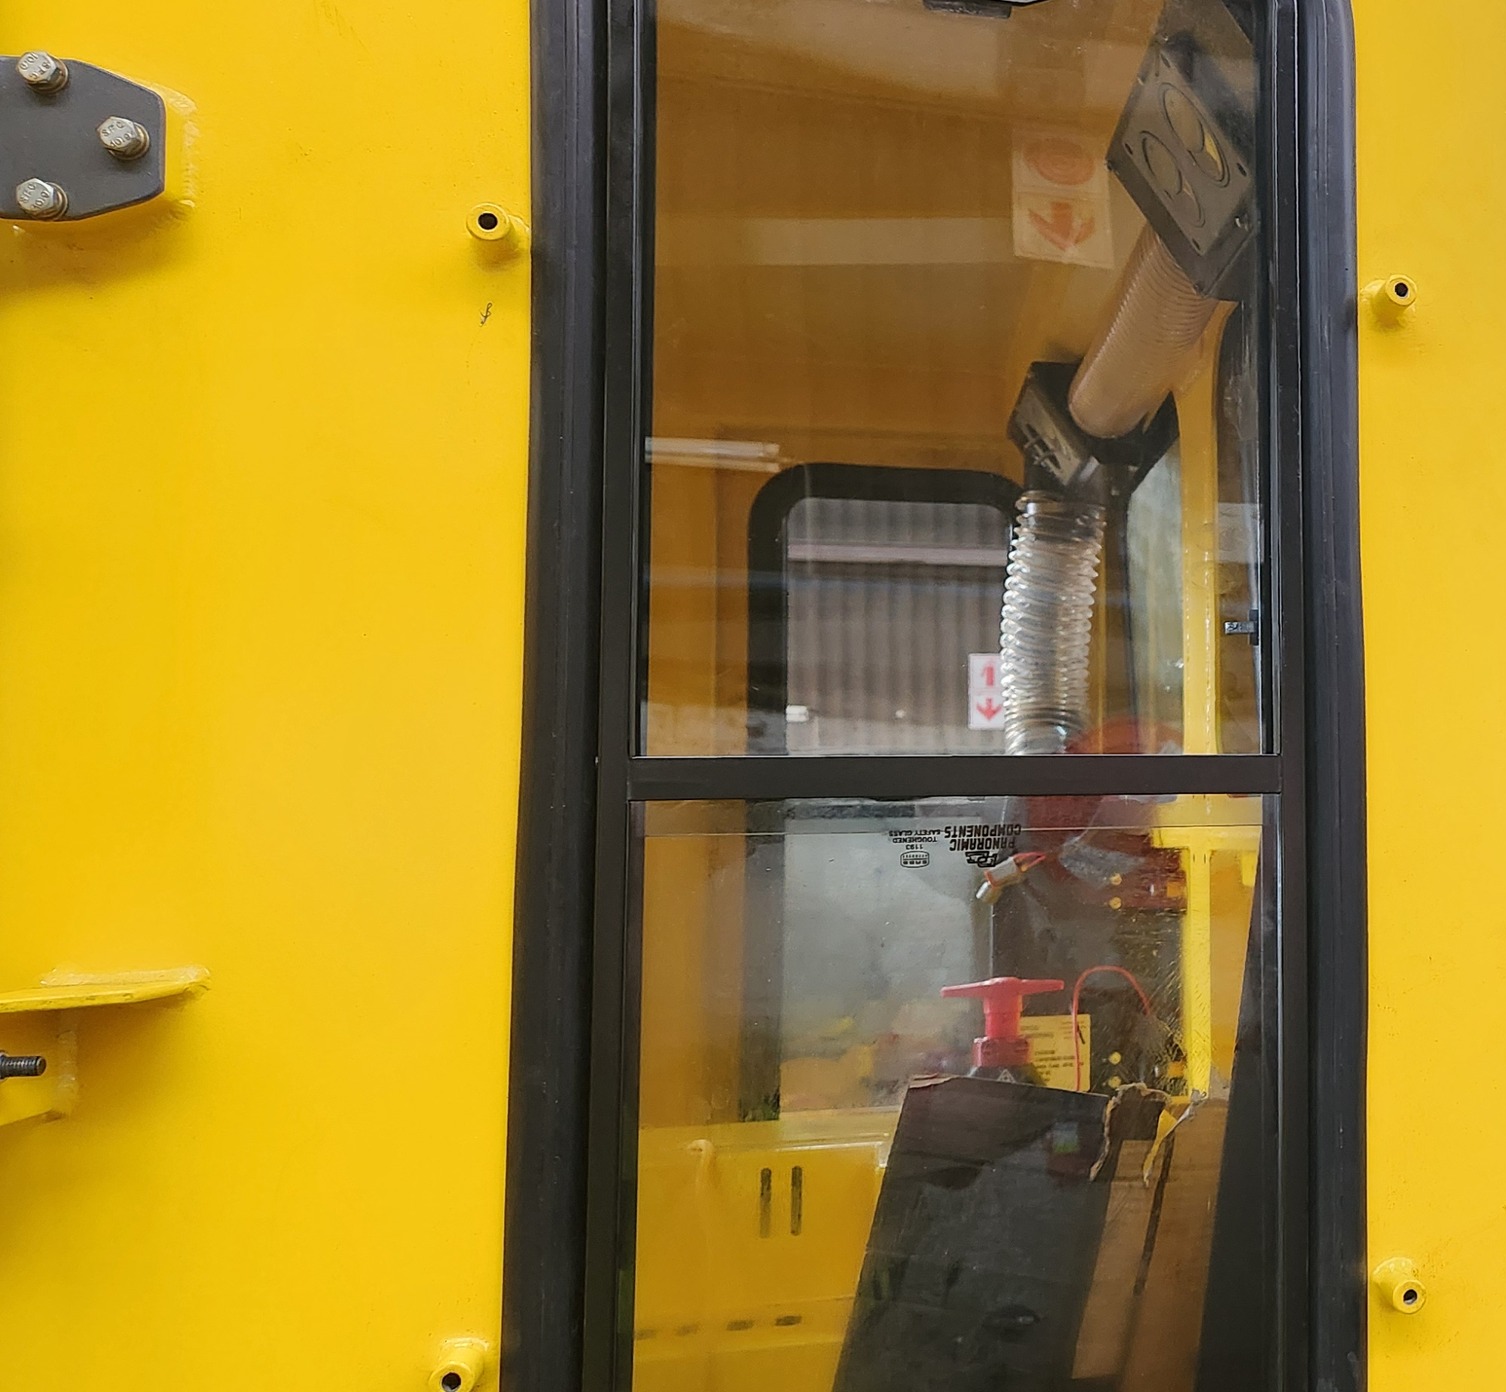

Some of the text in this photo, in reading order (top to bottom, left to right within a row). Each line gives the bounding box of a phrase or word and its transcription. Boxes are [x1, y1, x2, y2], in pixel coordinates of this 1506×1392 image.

[888, 829, 941, 837] SAFETY GLASS
[944, 824, 1022, 838] COMPONENTS
[892, 836, 937, 844] TOUGHENED
[949, 837, 1016, 851] PANORAMIC
